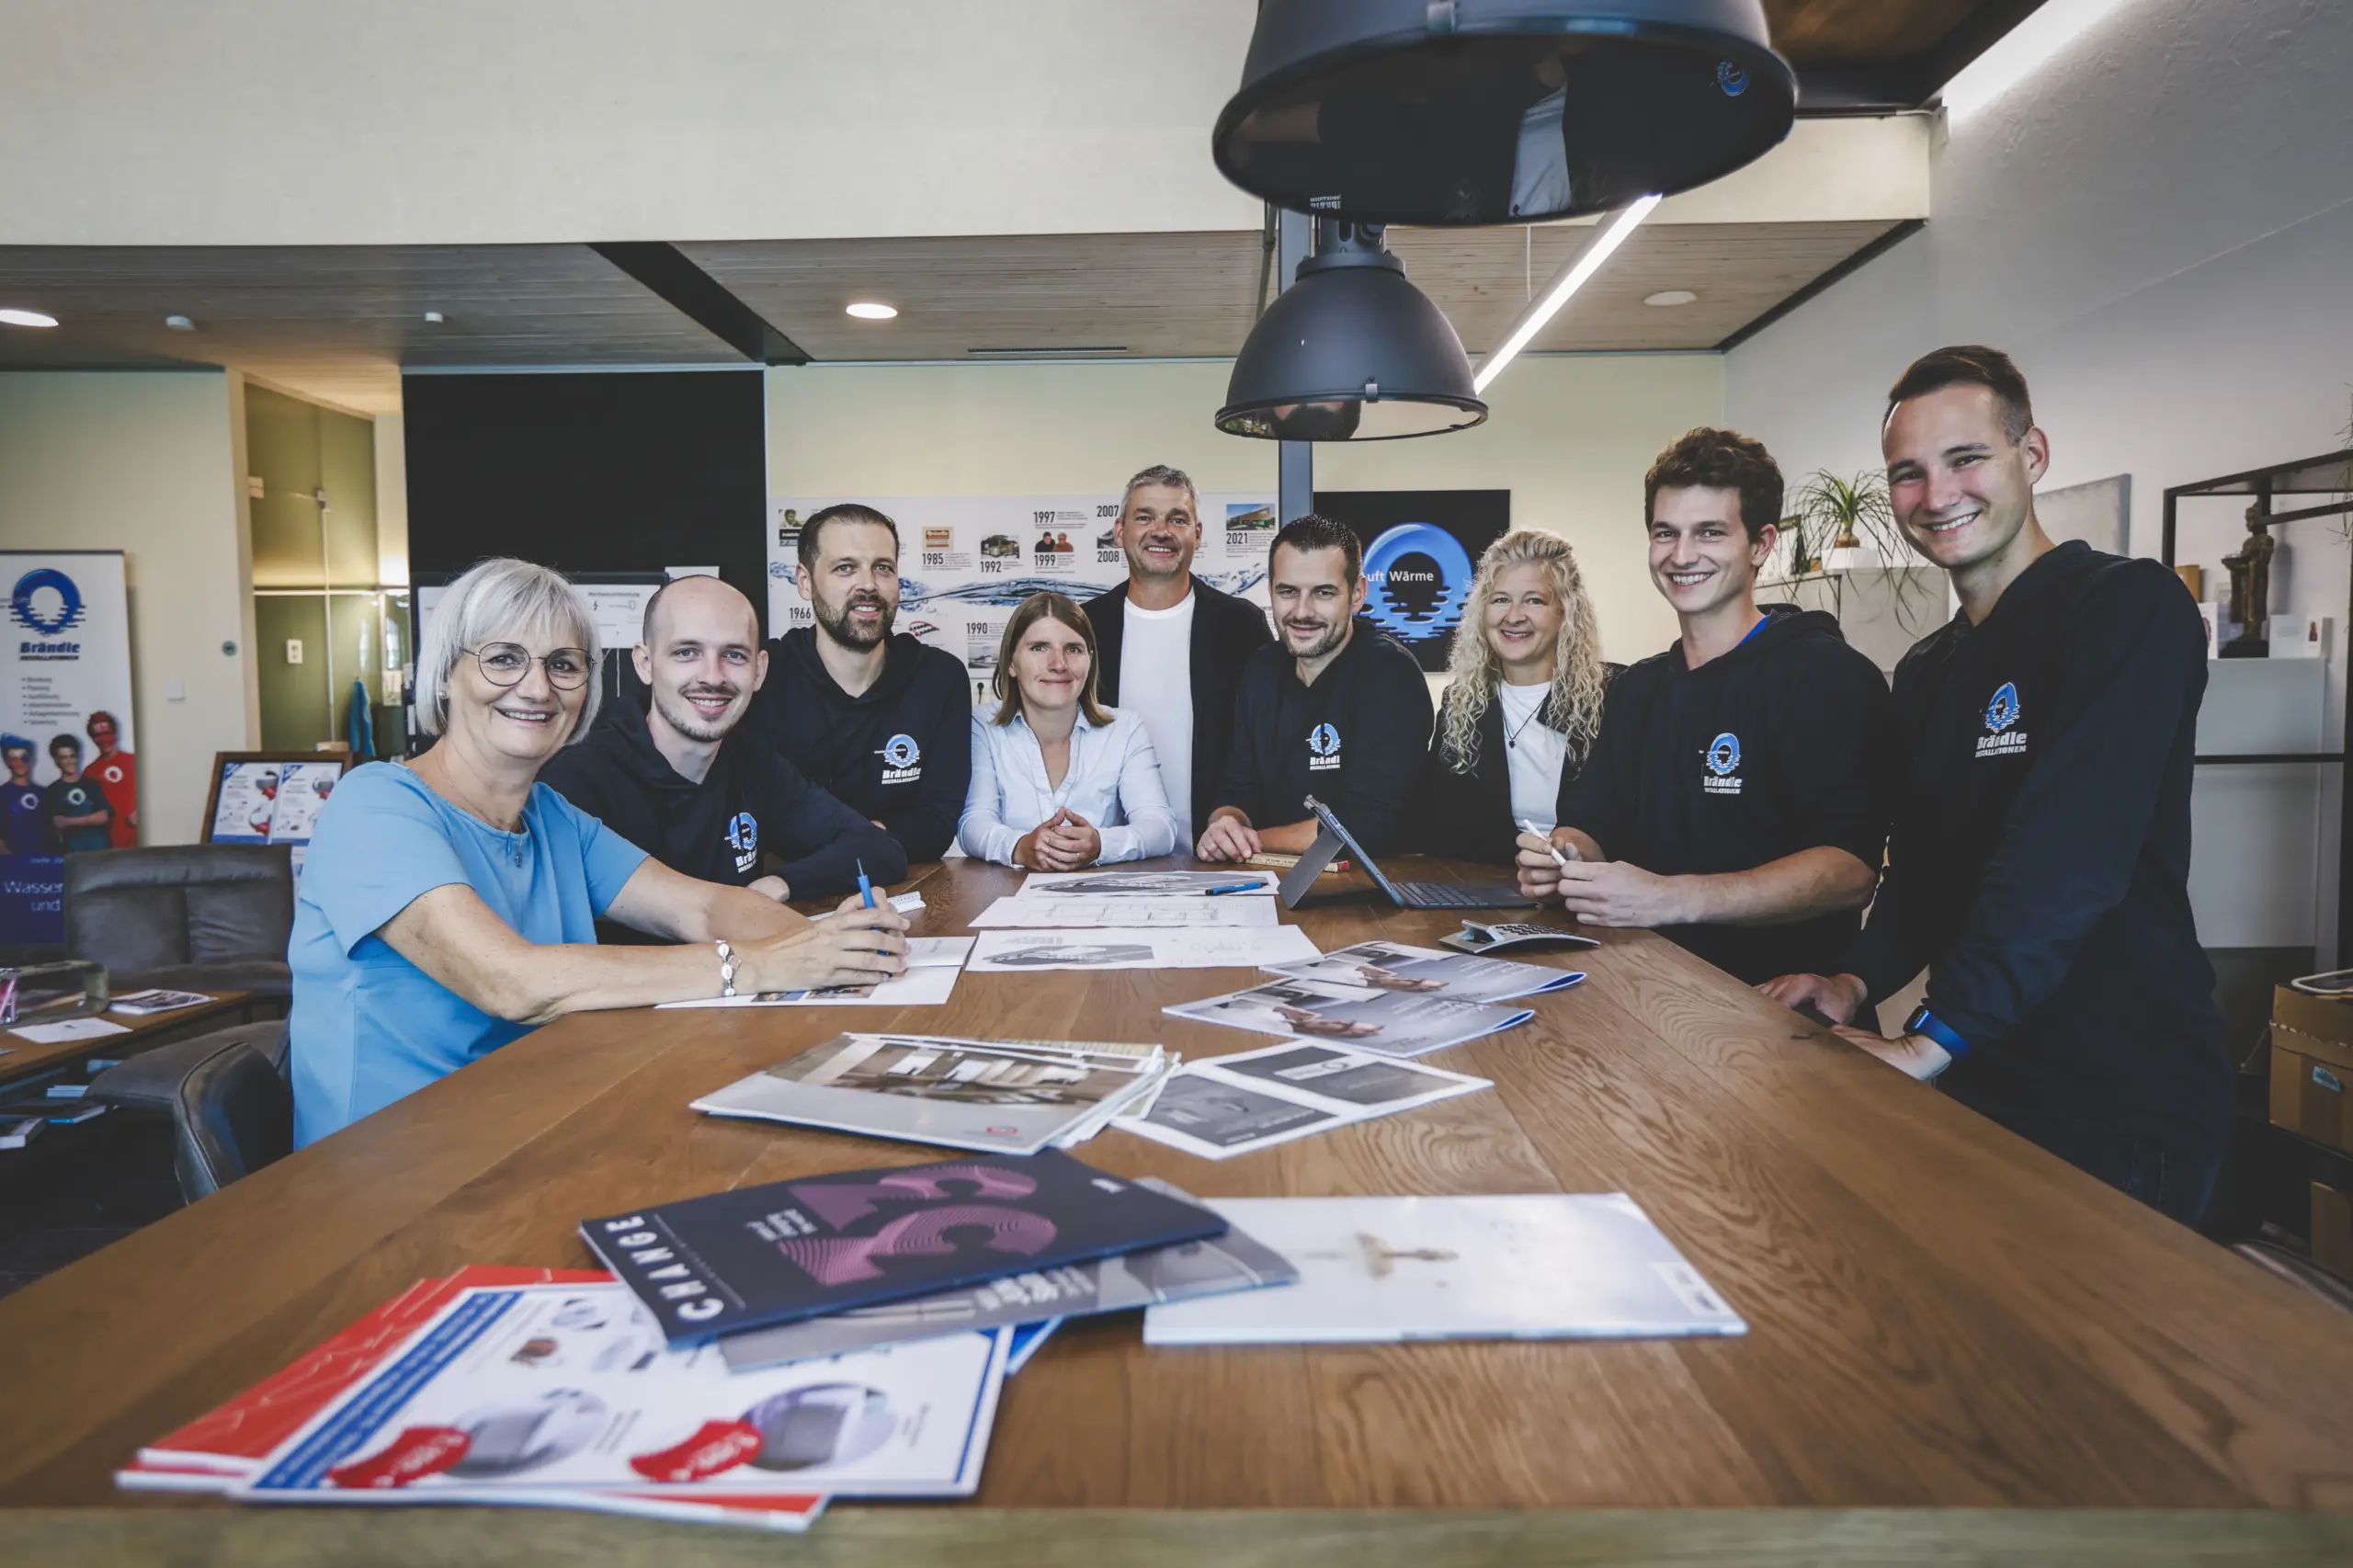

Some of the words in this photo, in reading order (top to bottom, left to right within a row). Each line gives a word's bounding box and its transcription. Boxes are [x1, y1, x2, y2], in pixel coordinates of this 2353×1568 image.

[1034, 511, 1055, 523] 1997
[1097, 505, 1120, 517] 2007
[1226, 532, 1248, 544] 2021
[922, 552, 944, 565] 1985
[1034, 554, 1056, 566] 1999
[1097, 551, 1120, 562] 2008
[980, 561, 1002, 573] 1992
[1364, 570, 1385, 582] uft
[1389, 570, 1434, 582] Wärme
[790, 608, 812, 619] 1966
[966, 622, 988, 634] 1990
[1977, 732, 2028, 750] Brändle
[882, 767, 922, 779] Brändle
[1703, 776, 1743, 788] Brändle
[4, 881, 64, 894] Wasser
[30, 899, 61, 913] und
[605, 1215, 724, 1321] CHANGE
